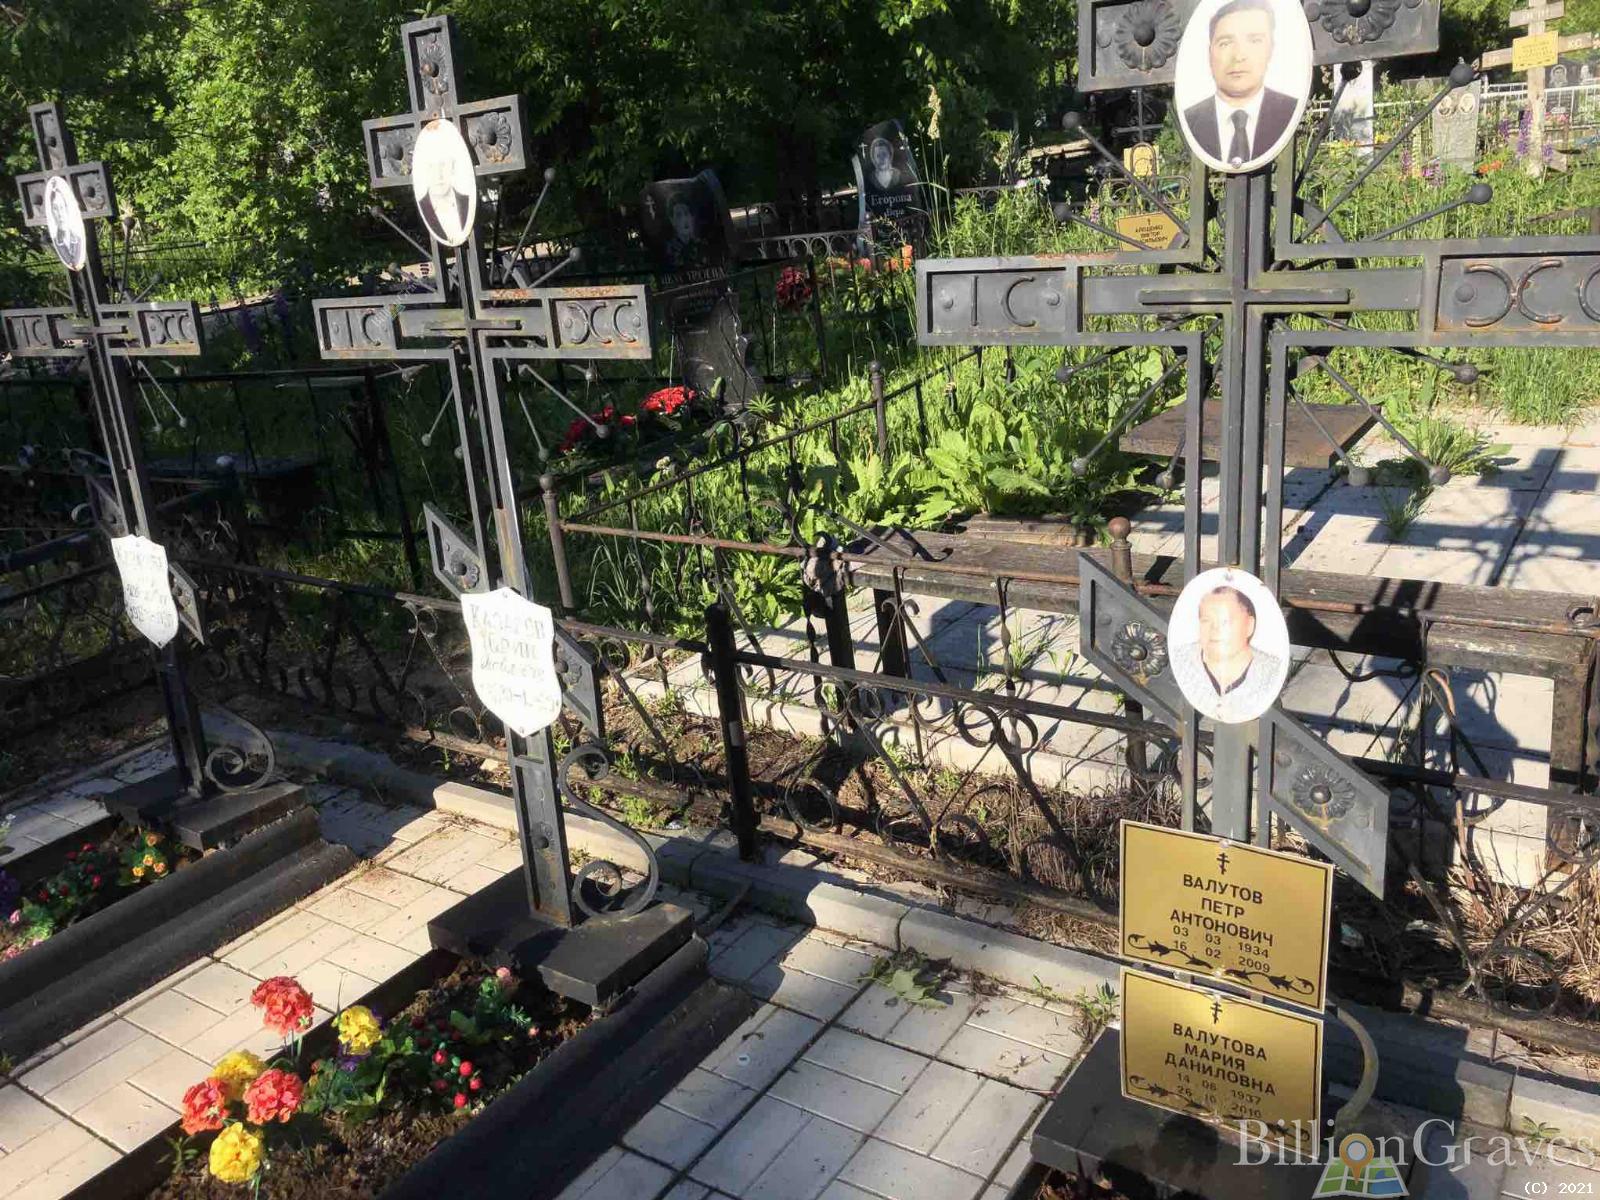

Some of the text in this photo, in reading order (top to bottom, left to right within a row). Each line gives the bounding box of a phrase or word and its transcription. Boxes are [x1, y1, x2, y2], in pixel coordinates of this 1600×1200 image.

[1183, 873, 1263, 904] ВАЛУТОВ
[1201, 897, 1245, 918] ПЕТР
[1170, 909, 1274, 947] АНТОНОВИЧ
[1238, 956, 1271, 973] 2009
[1173, 1022, 1268, 1061] ВАЛУТОВА
[1184, 1043, 1245, 1071] МАРИЯ
[1164, 1052, 1276, 1096] ДАНИЛОВНА
